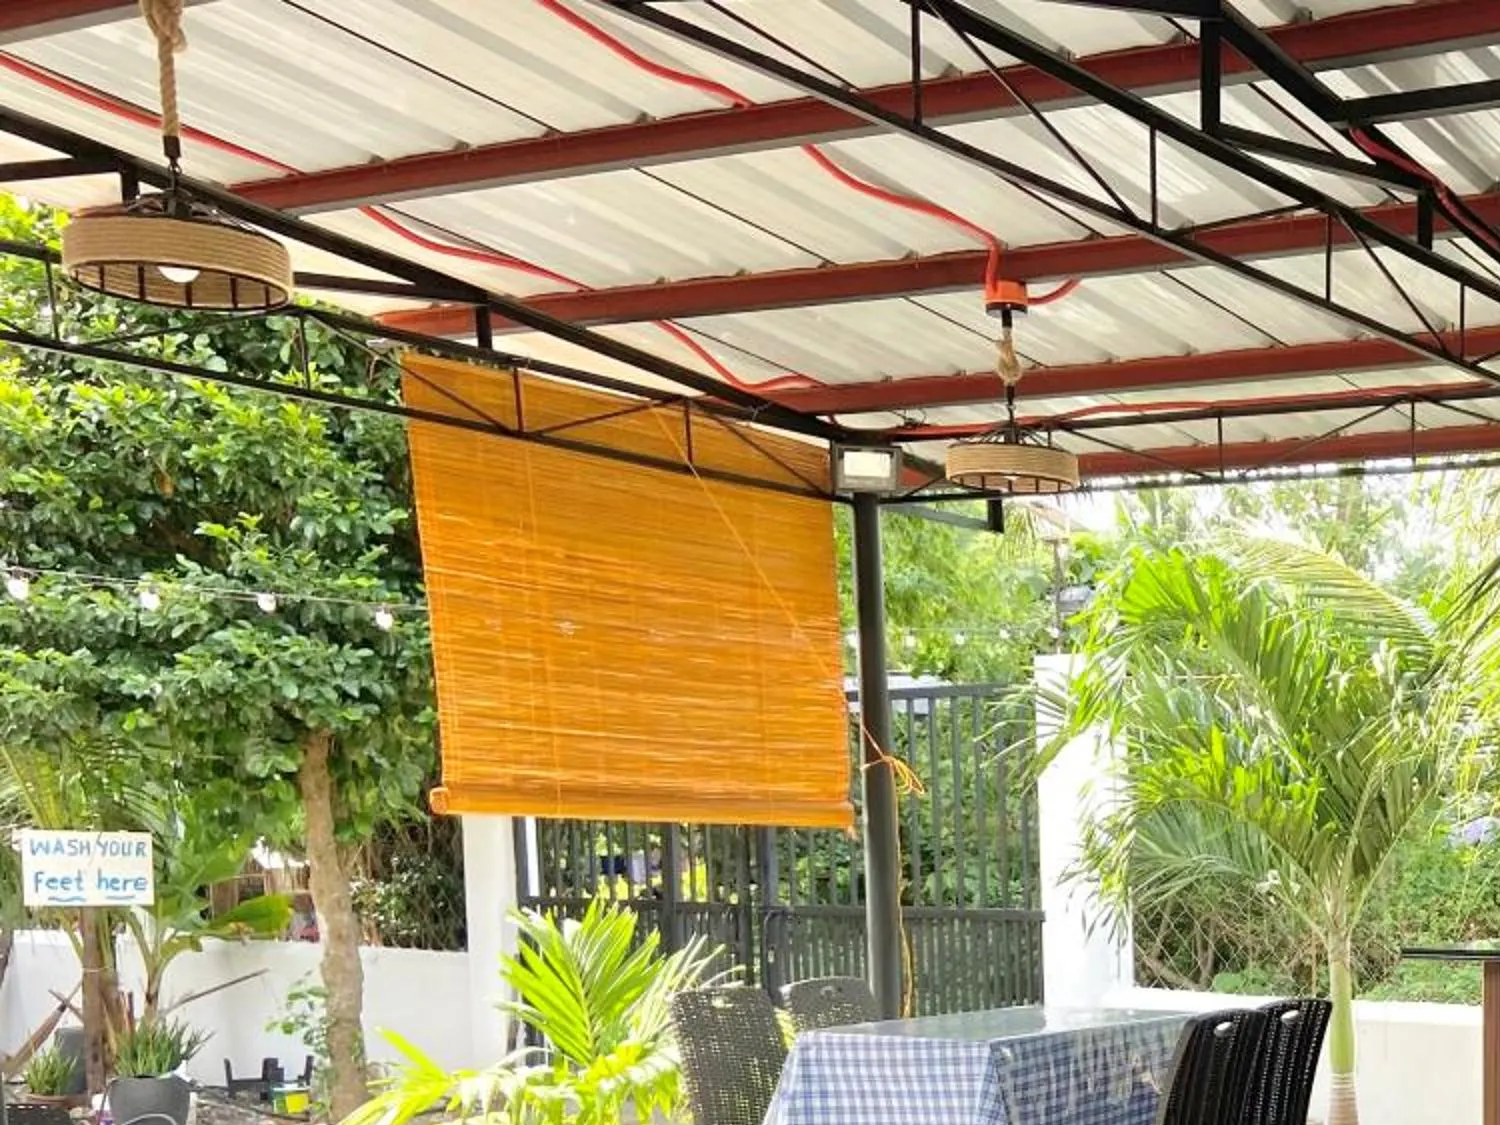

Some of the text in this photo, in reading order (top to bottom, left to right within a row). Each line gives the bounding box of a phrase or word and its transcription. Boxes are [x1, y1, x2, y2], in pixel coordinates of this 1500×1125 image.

[29, 838, 147, 857] WASH YOUR
[96, 867, 148, 891] here
